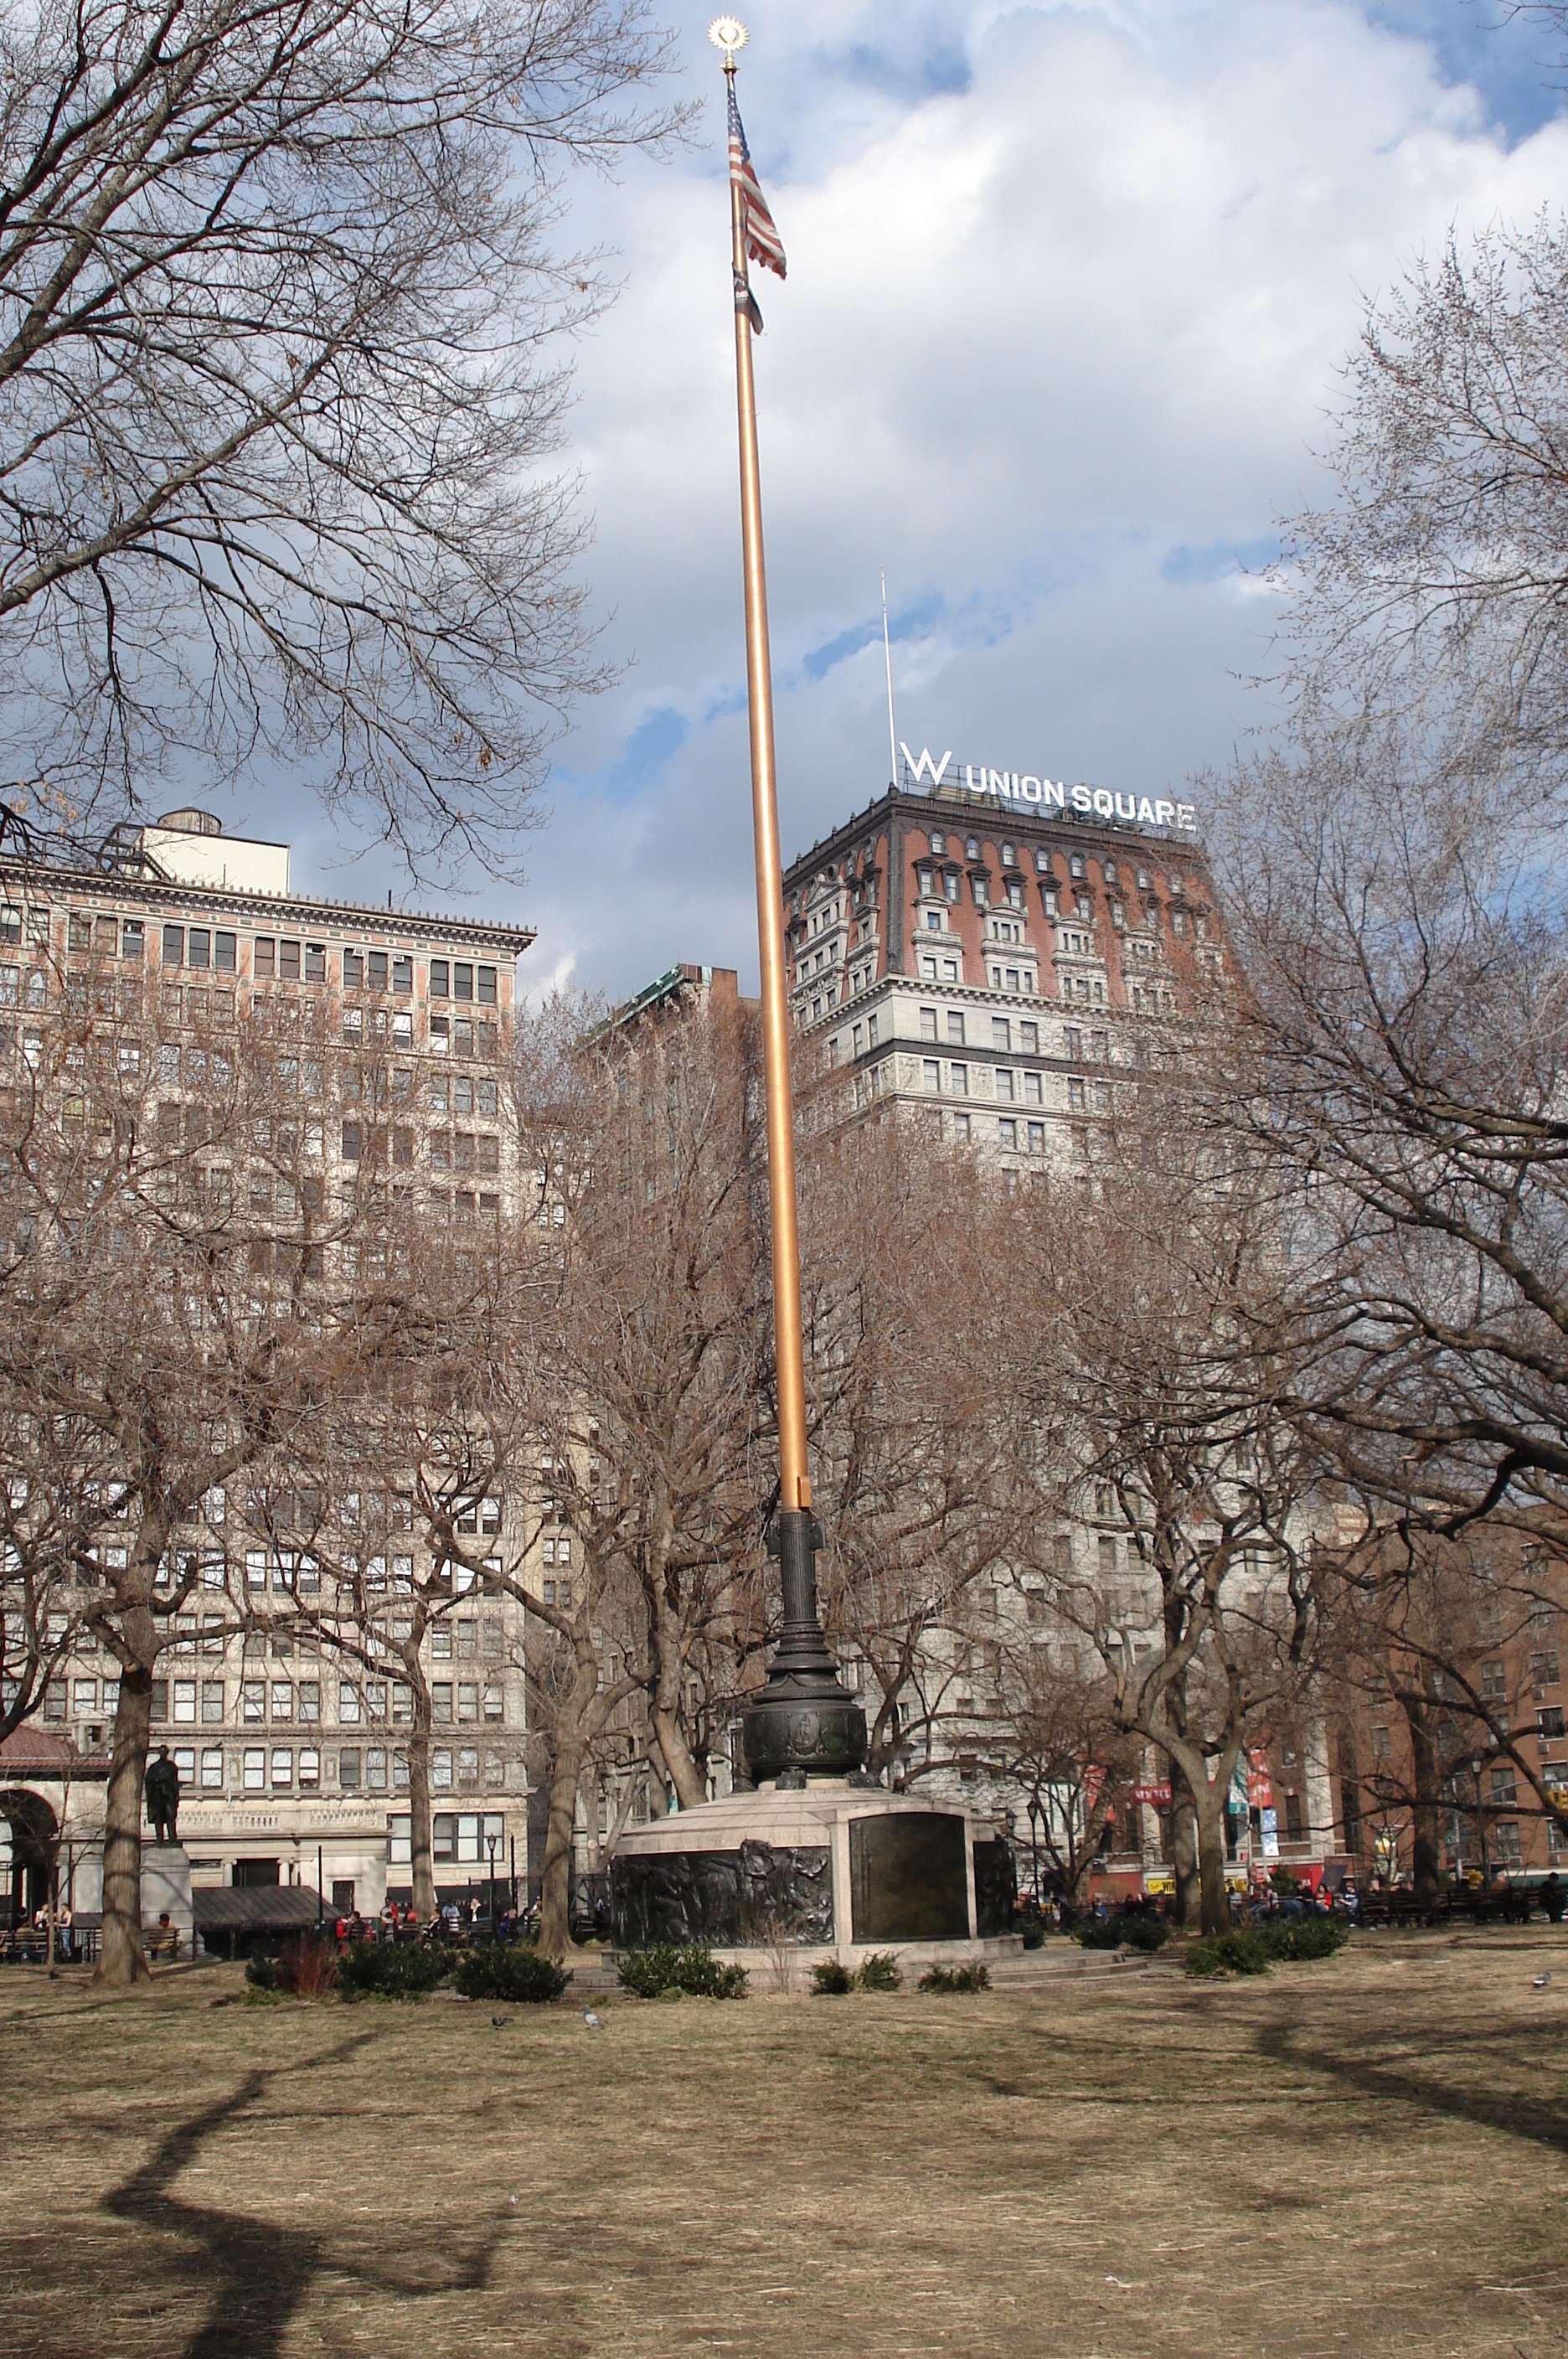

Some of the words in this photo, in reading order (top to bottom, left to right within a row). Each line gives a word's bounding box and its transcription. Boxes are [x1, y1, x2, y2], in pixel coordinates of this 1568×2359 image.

[899, 741, 952, 786] W
[966, 764, 1065, 808] UNION
[1070, 784, 1197, 832] SQUARE
